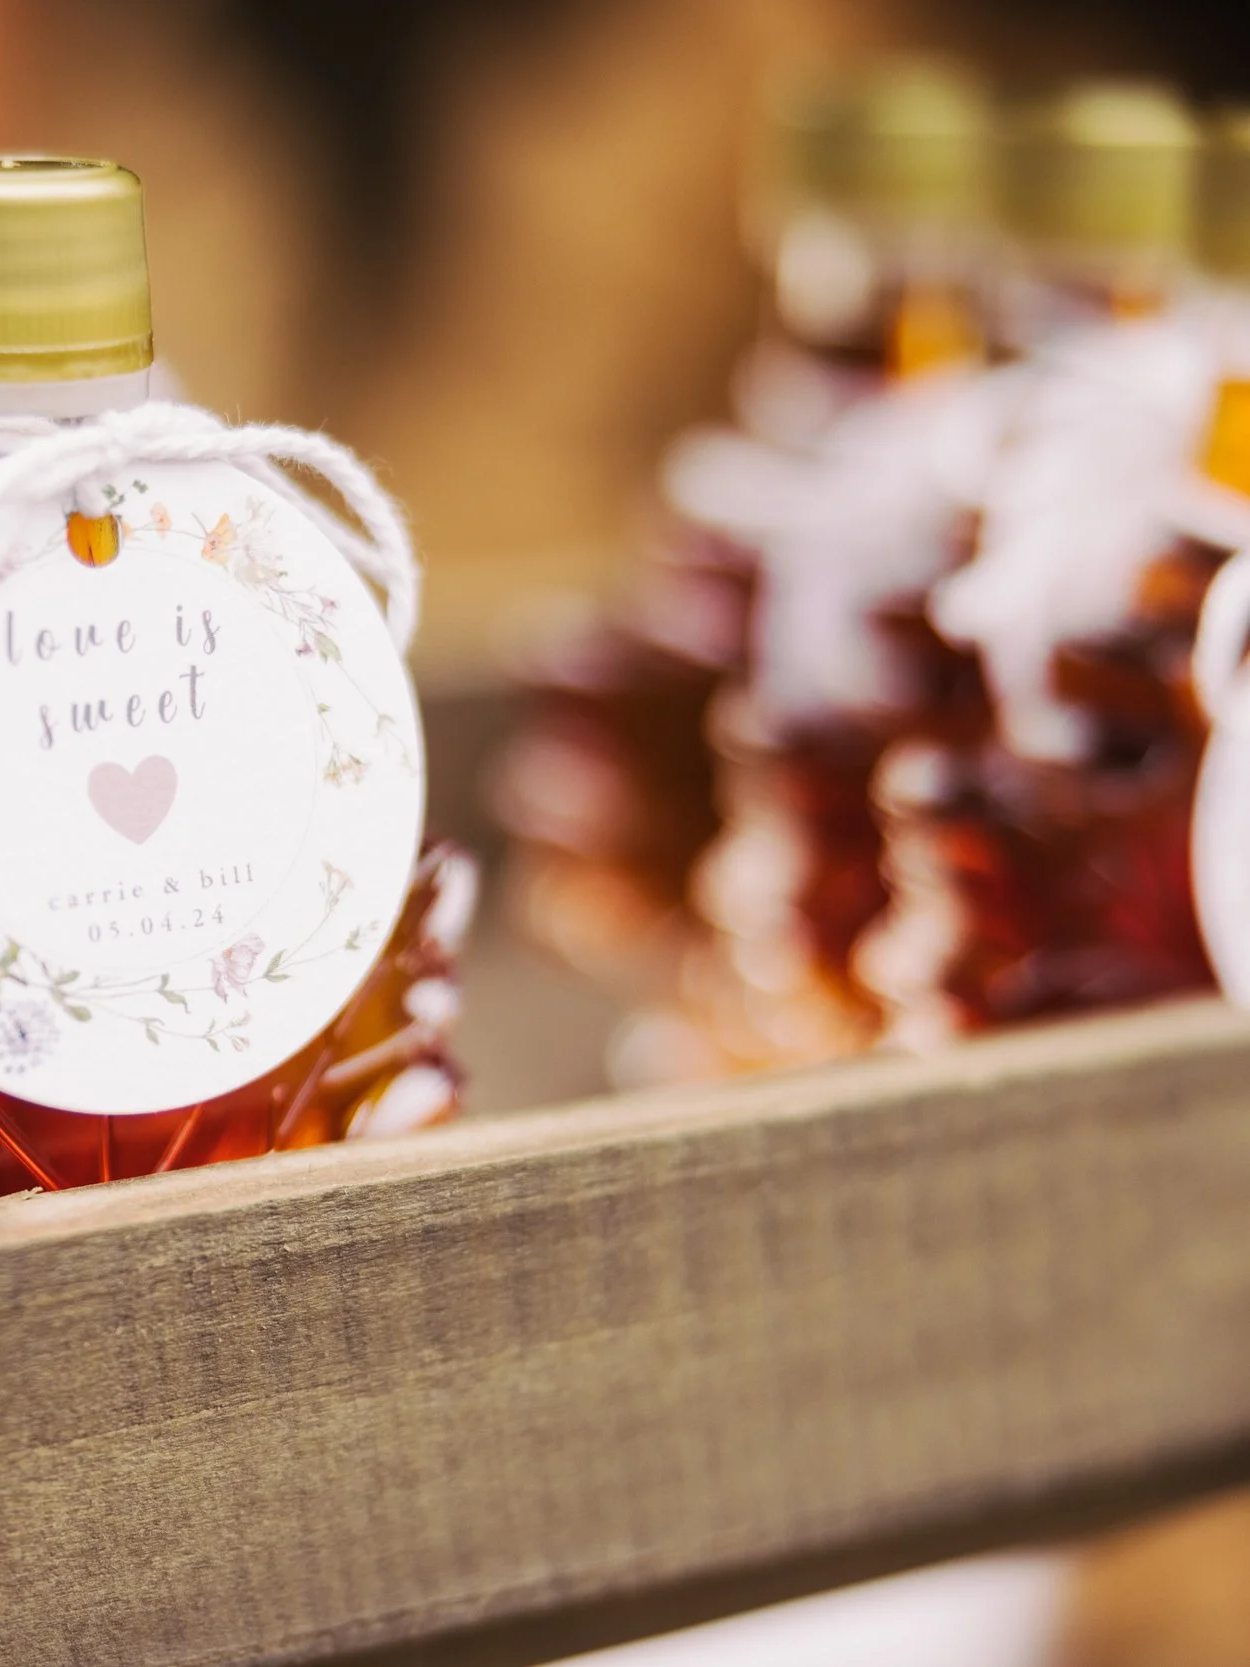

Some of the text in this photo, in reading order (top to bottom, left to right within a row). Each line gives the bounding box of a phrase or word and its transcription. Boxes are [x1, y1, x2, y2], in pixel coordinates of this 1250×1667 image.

[6, 604, 221, 666] love is
[39, 664, 206, 750] sweet
[47, 863, 254, 912] carrie & bill
[87, 903, 224, 943] 05.04.24
